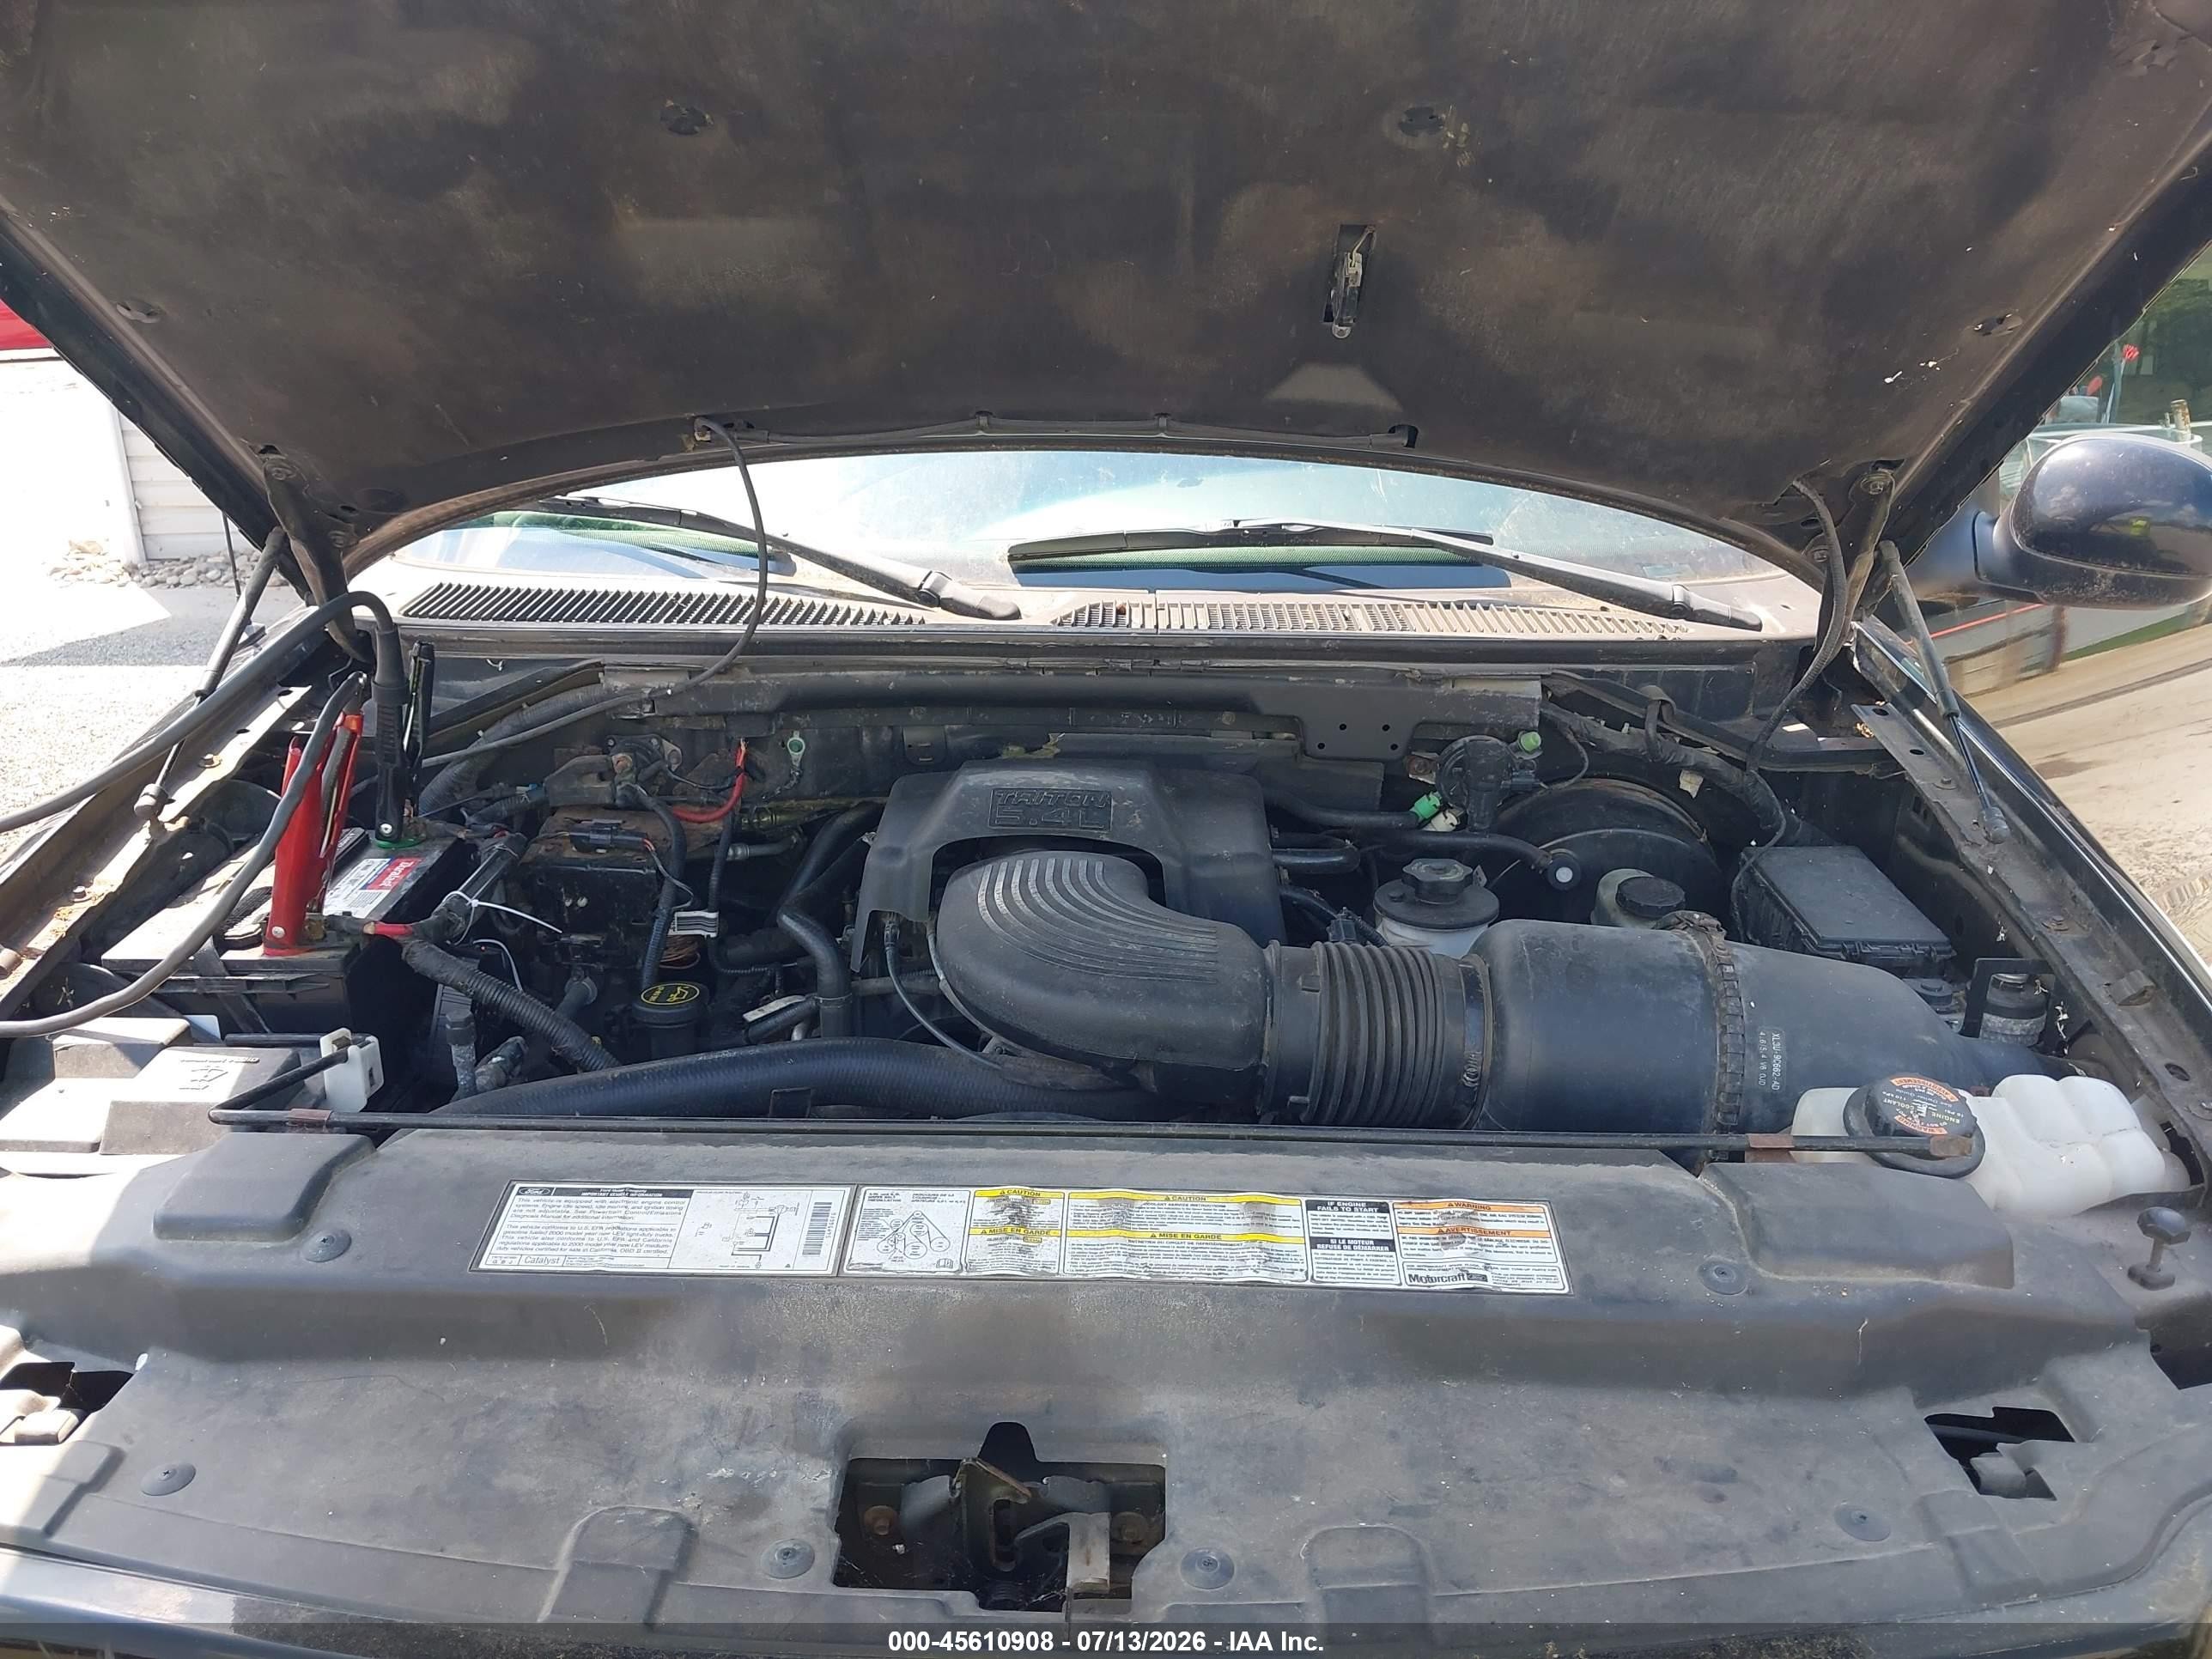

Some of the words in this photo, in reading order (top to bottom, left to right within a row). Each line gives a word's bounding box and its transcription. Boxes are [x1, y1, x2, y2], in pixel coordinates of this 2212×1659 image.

[995, 789, 1108, 807] TRITON
[994, 805, 1104, 829] 5.4L
[1882, 1097, 1915, 1110] COOLANT
[1931, 1111, 1960, 1124] ENGINE
[1454, 1202, 1492, 1210] WARNING
[1446, 1227, 1511, 1236] AVERTISSEMENT
[524, 1256, 560, 1265] Catalyst
[1408, 1273, 1466, 1284] Motorcraft
